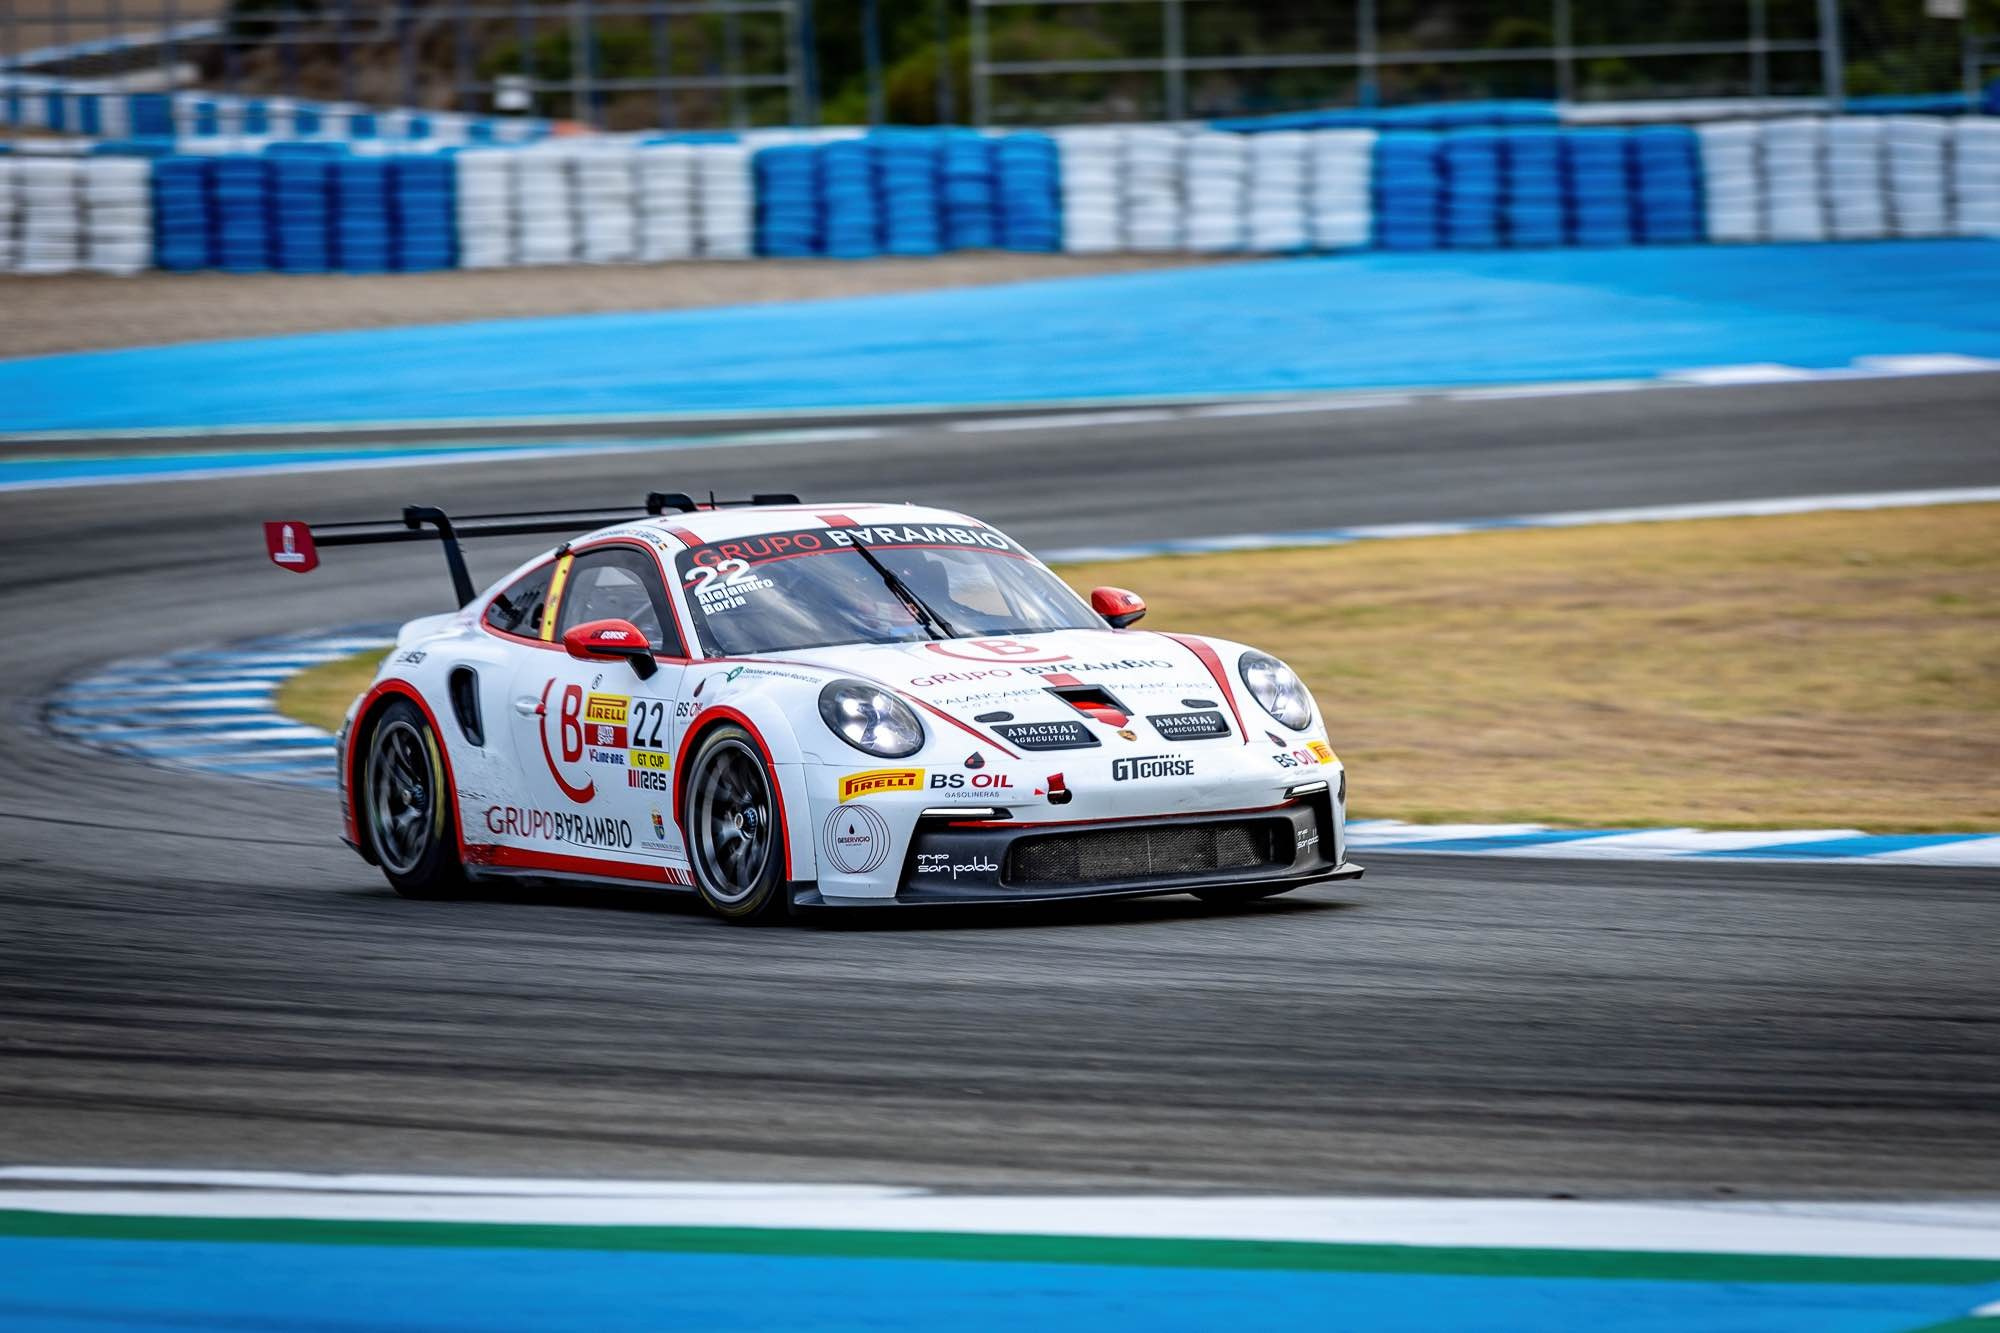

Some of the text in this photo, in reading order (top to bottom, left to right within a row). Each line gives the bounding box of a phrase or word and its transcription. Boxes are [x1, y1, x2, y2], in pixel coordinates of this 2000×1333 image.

[692, 534, 822, 567] GRUPO
[684, 558, 758, 597] 22
[910, 669, 1012, 687] GRUPO
[586, 697, 627, 721] PIRELLI
[676, 702, 689, 717] BS
[633, 701, 664, 748] 22
[1155, 716, 1216, 728] ANACHAL
[1007, 724, 1079, 738] ANACHAL
[1163, 726, 1217, 735] AGRICULTURA
[1014, 733, 1077, 744] AGRICULTURA
[637, 754, 664, 768] GT CUP
[1272, 753, 1298, 768] BS
[1293, 749, 1319, 765] OIL
[845, 772, 917, 797] PIRELLI
[930, 774, 1014, 789] BS OIL
[944, 791, 1000, 799] GASOLINERAS
[917, 854, 949, 864] grupo
[918, 856, 999, 880] san pablo
